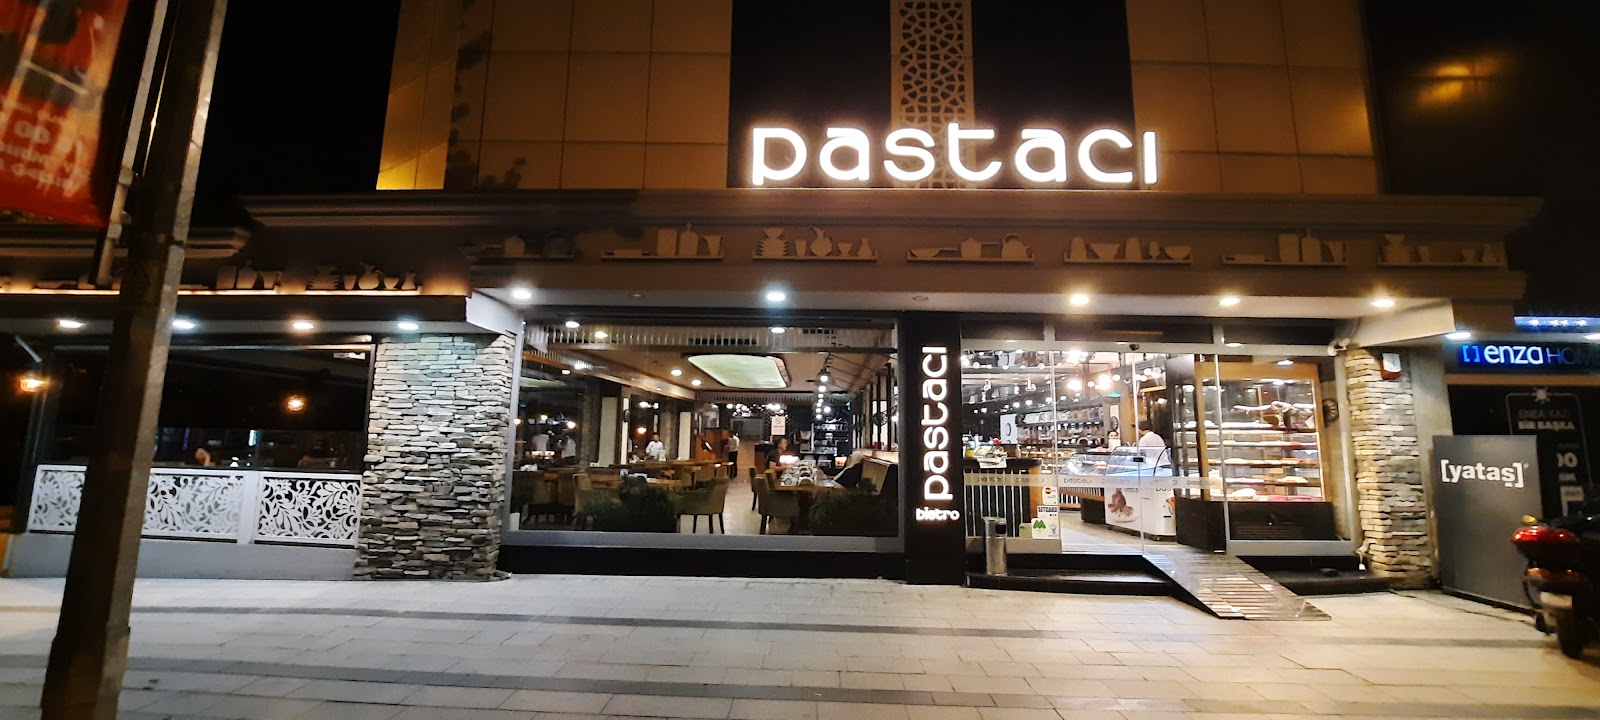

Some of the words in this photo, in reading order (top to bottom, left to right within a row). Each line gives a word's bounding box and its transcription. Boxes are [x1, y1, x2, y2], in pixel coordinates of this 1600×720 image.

[752, 121, 1159, 186] pastacı
[1484, 344, 1545, 366] enza
[920, 346, 953, 501] pastacı
[915, 506, 960, 521] bistro
